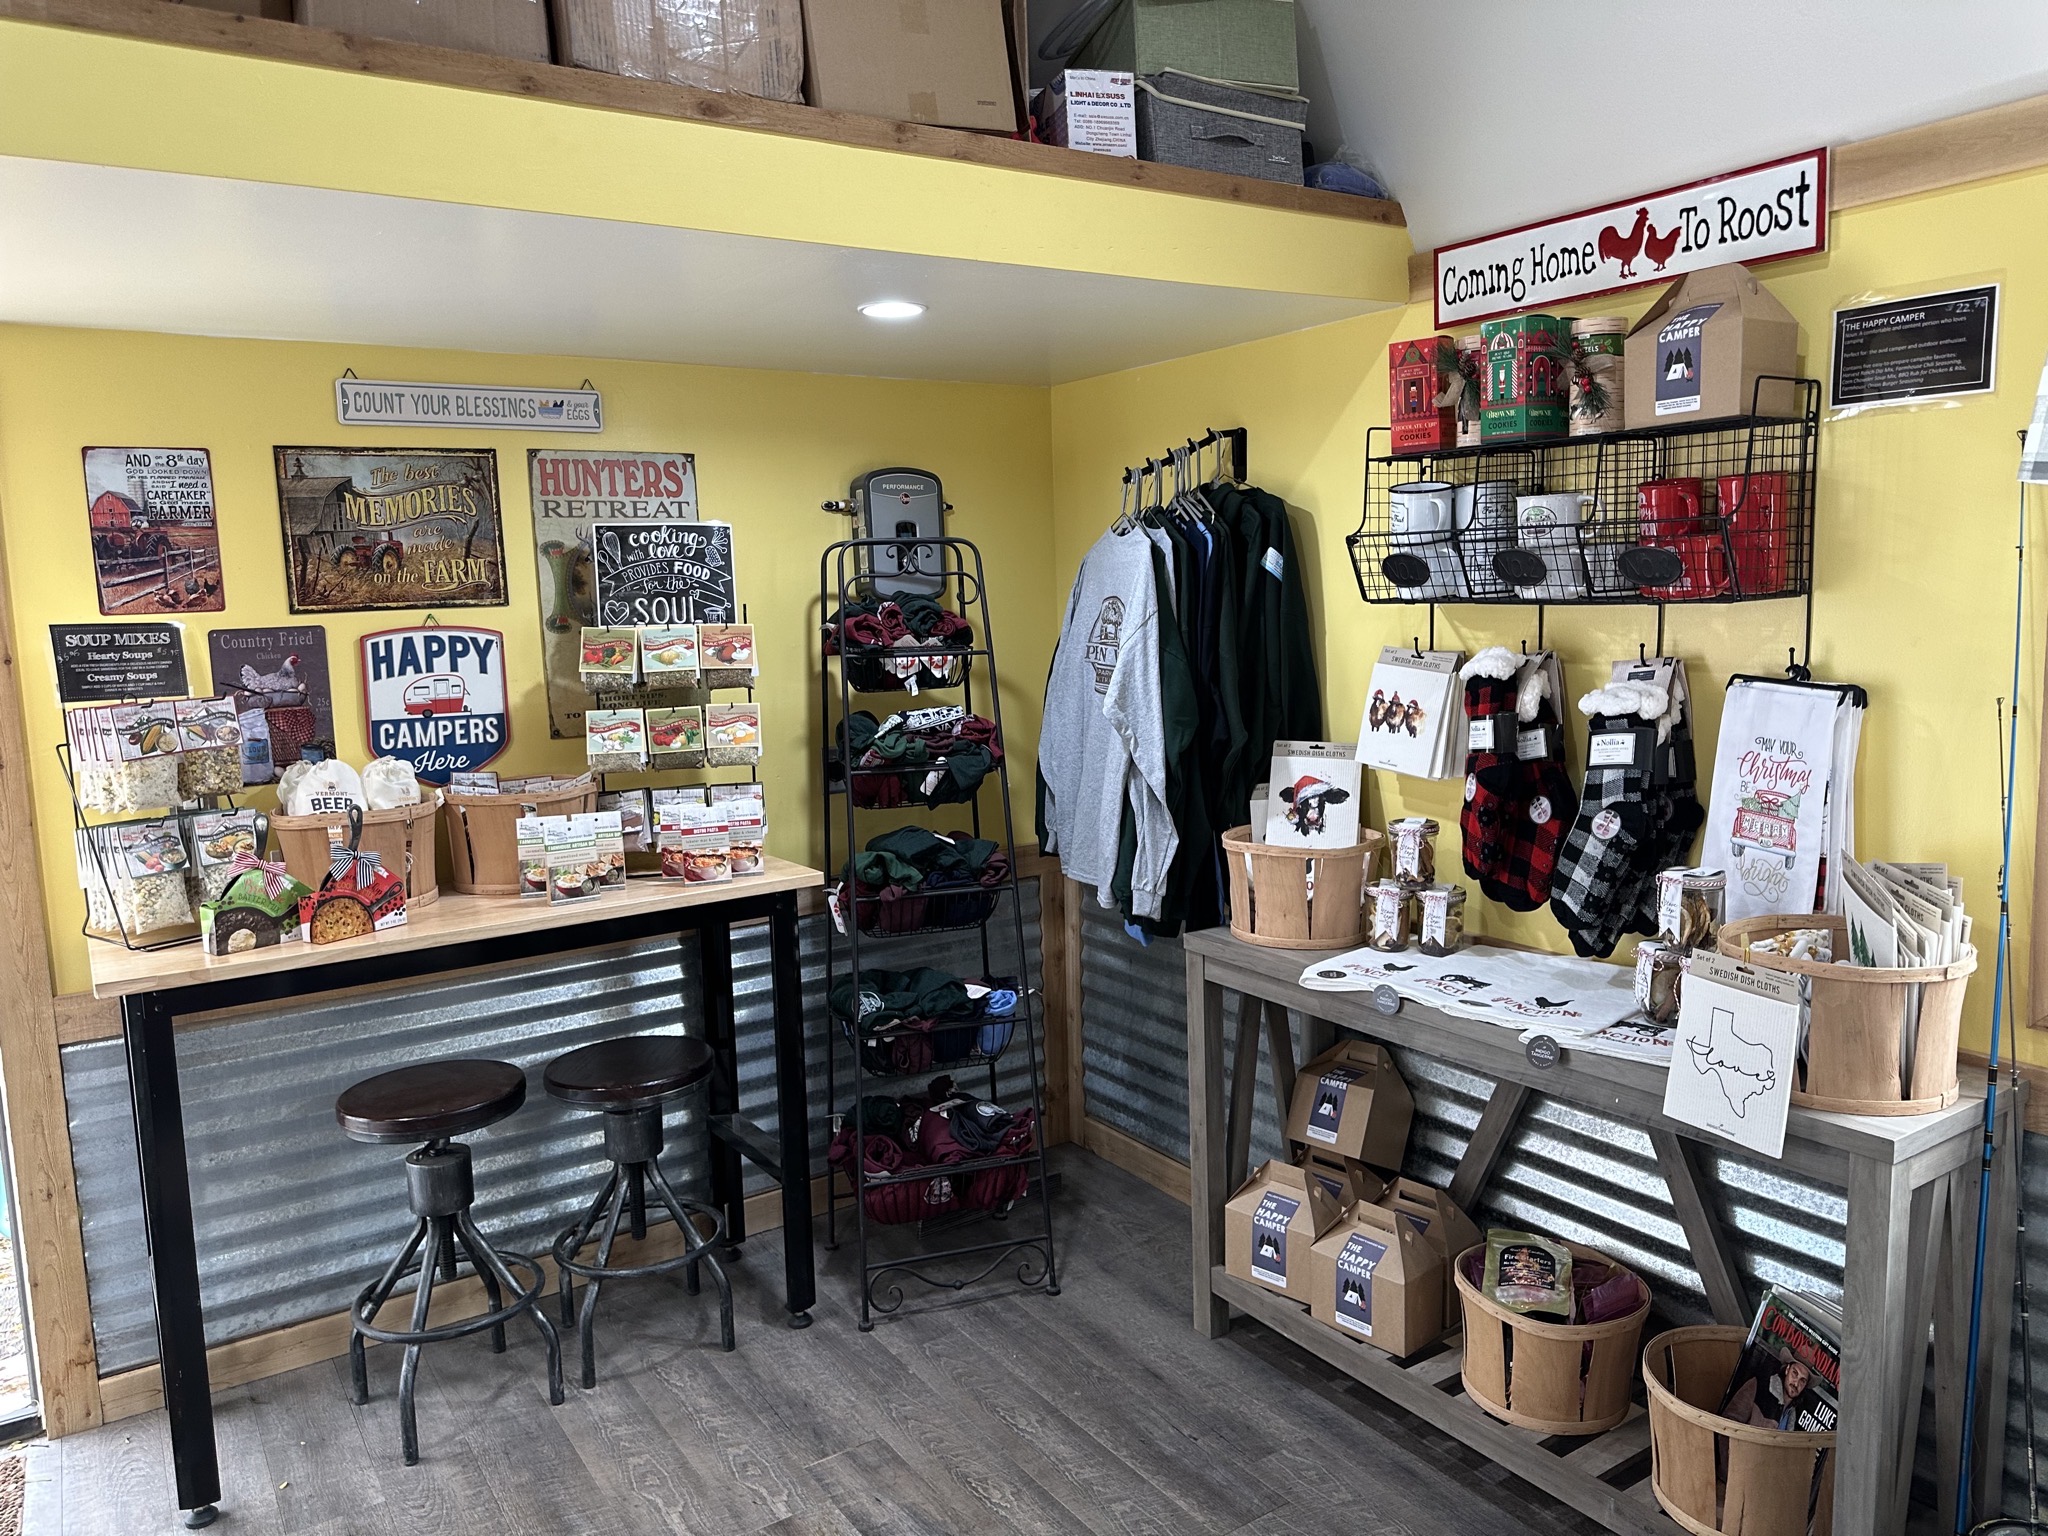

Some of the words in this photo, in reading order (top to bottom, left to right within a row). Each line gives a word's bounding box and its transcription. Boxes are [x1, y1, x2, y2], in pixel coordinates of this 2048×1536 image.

[1443, 257, 1526, 304] Coming
[1530, 241, 1598, 287] Home
[1680, 206, 1710, 254] To
[1718, 170, 1810, 244] Roost
[1662, 318, 1708, 332] HAPPY
[1672, 314, 1690, 322] THE
[1846, 322, 1860, 331] THE
[1862, 318, 1888, 329] HAPPY
[1890, 312, 1926, 324] CAMPER
[1659, 326, 1700, 343] CAMPER
[1864, 328, 1891, 336] comfortable
[354, 391, 405, 414] COUNT
[410, 394, 450, 416] YOUR
[456, 396, 536, 418] BLESSINGS
[574, 401, 589, 409] your
[567, 409, 590, 420] EGGS
[1486, 410, 1517, 419] BROWNIE
[1530, 419, 1553, 427] COOKIES
[1392, 423, 1422, 431] CHOCOLATE
[1488, 420, 1518, 430] COOKIES
[1400, 432, 1432, 441] COOKIES
[125, 454, 152, 467] AND
[166, 454, 184, 467] 8th
[186, 456, 205, 468] day
[371, 466, 398, 487] The
[404, 463, 440, 480] best
[537, 458, 688, 499] HUNTERS'
[178, 481, 199, 489] need
[148, 506, 212, 519] FARMER
[344, 484, 478, 526] MEMORIES
[540, 500, 690, 519] RETREAT
[413, 526, 444, 538] are
[629, 525, 707, 556] cooking
[407, 535, 454, 554] made
[626, 548, 645, 562] with
[646, 544, 684, 560] love
[374, 572, 391, 584] on
[397, 568, 418, 583] the
[422, 558, 488, 585] FARM
[621, 562, 669, 583] PROVIDES
[674, 562, 711, 580] FOOD
[642, 578, 663, 594] for
[664, 575, 692, 590] the
[632, 596, 704, 624] SOUL
[65, 634, 111, 647] SOUP
[114, 632, 171, 646] MIXES
[220, 634, 274, 650] Country
[279, 632, 313, 646] Fried
[87, 651, 120, 661] Hearty
[122, 651, 153, 661] Soups
[371, 635, 494, 681] HAPPY
[1392, 656, 1411, 664] SWEDISH
[1423, 661, 1441, 669] CLOTHS
[87, 673, 124, 683] Creamy
[126, 672, 158, 682] Soups
[380, 717, 499, 750] CAMPERS
[1755, 737, 1776, 753] MAY
[1779, 739, 1804, 759] YOUR
[415, 750, 470, 773] Here
[1737, 750, 1812, 794] Christmas
[1740, 780, 1758, 794] BE
[1743, 816, 1789, 838] MERRY
[1759, 839, 1772, 847] AND
[1736, 856, 1790, 904] bright
[268, 902, 280, 914] MIX
[1904, 904, 1924, 922] CLOTHS
[1709, 966, 1739, 982] SWEDISH
[1740, 975, 1755, 987] DISH
[1756, 980, 1781, 995] CLOTHS
[1491, 997, 1578, 1018] JUNCTION
[1320, 1077, 1348, 1090] CAMPER
[1324, 1073, 1355, 1082] HAPPY
[1261, 1200, 1277, 1210] THE
[1254, 1216, 1286, 1234] CAMPER
[1256, 1208, 1290, 1225] HAPPY
[1346, 1241, 1363, 1253] THE
[1340, 1250, 1376, 1270] HAPPY
[1337, 1260, 1371, 1280] CAMPER
[1762, 1306, 1811, 1358] COWBOYS
[1794, 1316, 1809, 1331] ULTIMATE
[1808, 1328, 1822, 1342] WESTERN
[1821, 1338, 1830, 1348] GIFT
[1828, 1345, 1838, 1356] GUIDE
[1814, 1401, 1837, 1430] LUKE
